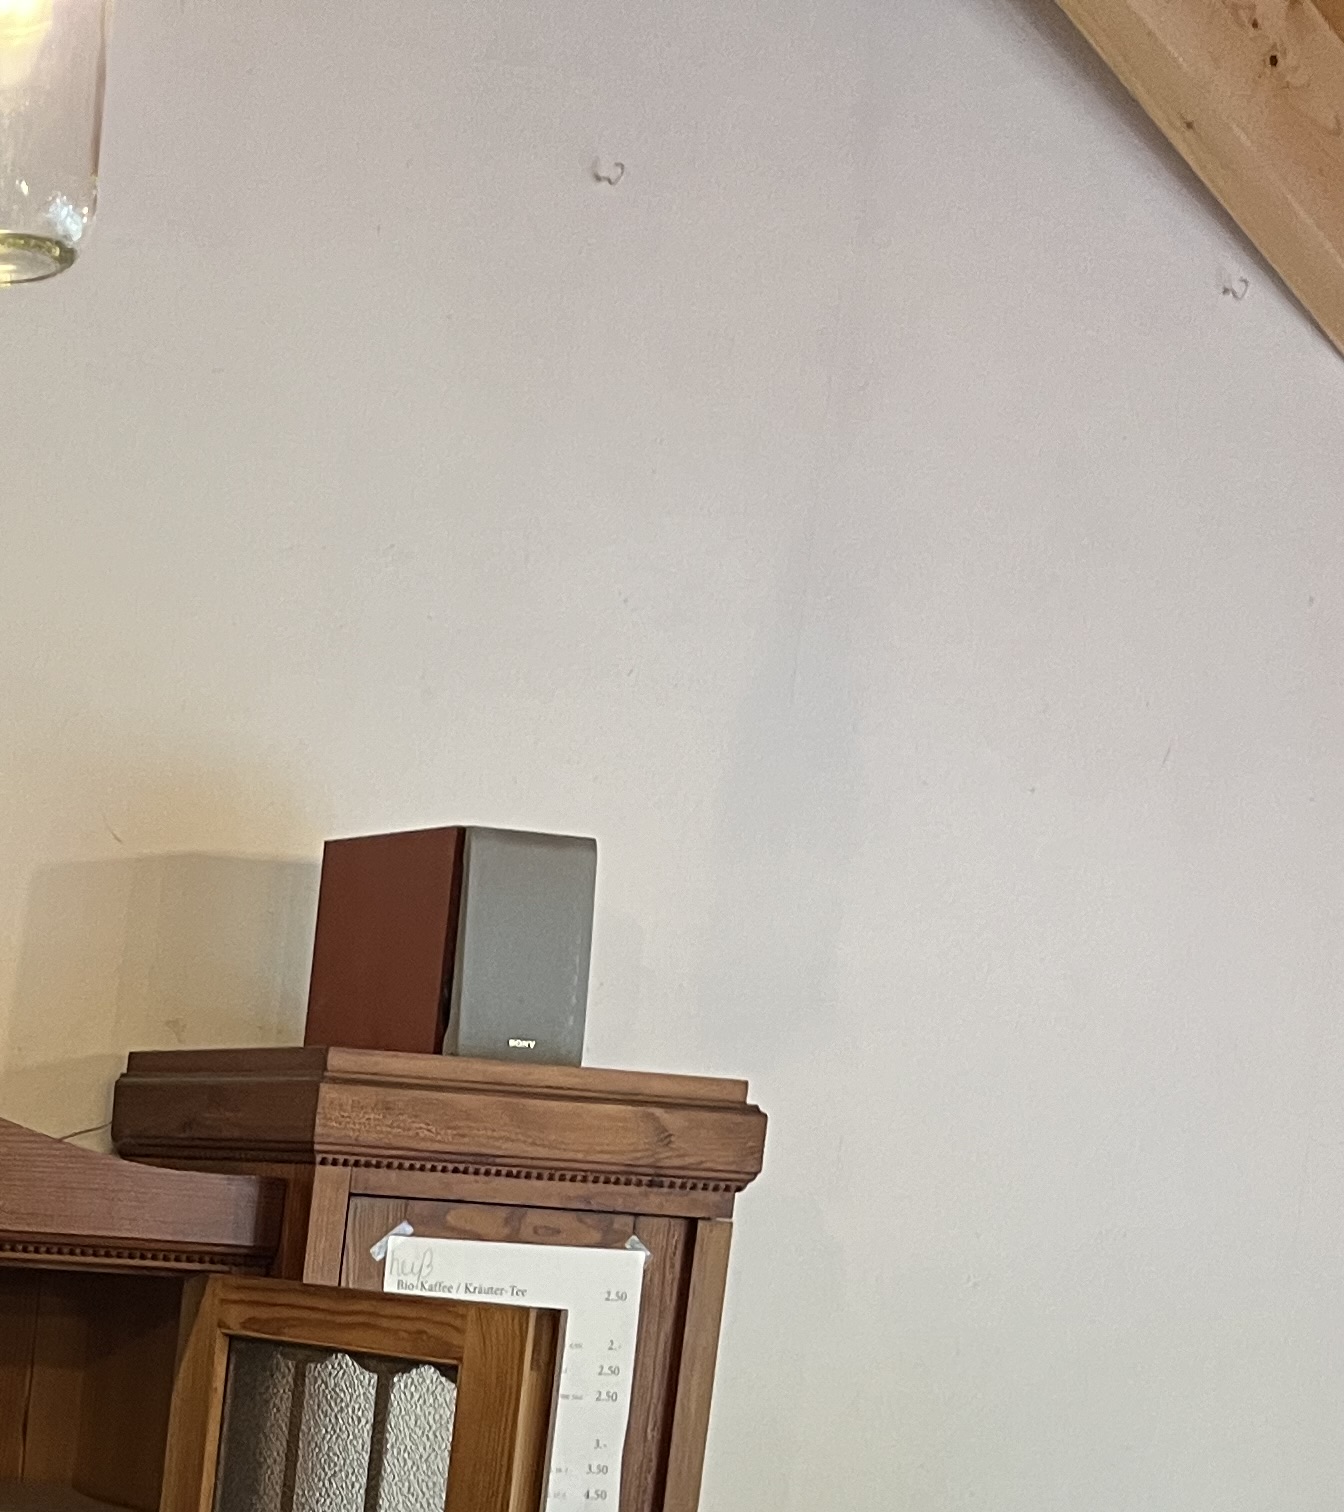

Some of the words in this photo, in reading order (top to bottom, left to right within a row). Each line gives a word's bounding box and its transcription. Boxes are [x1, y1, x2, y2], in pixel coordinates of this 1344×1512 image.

[508, 1038, 536, 1049] SONY
[605, 1291, 627, 1301] 2.50
[598, 1365, 620, 1376] 2.50
[595, 1391, 618, 1402] 2.50
[586, 1464, 608, 1475] 3.50
[584, 1489, 607, 1500] 4.50
